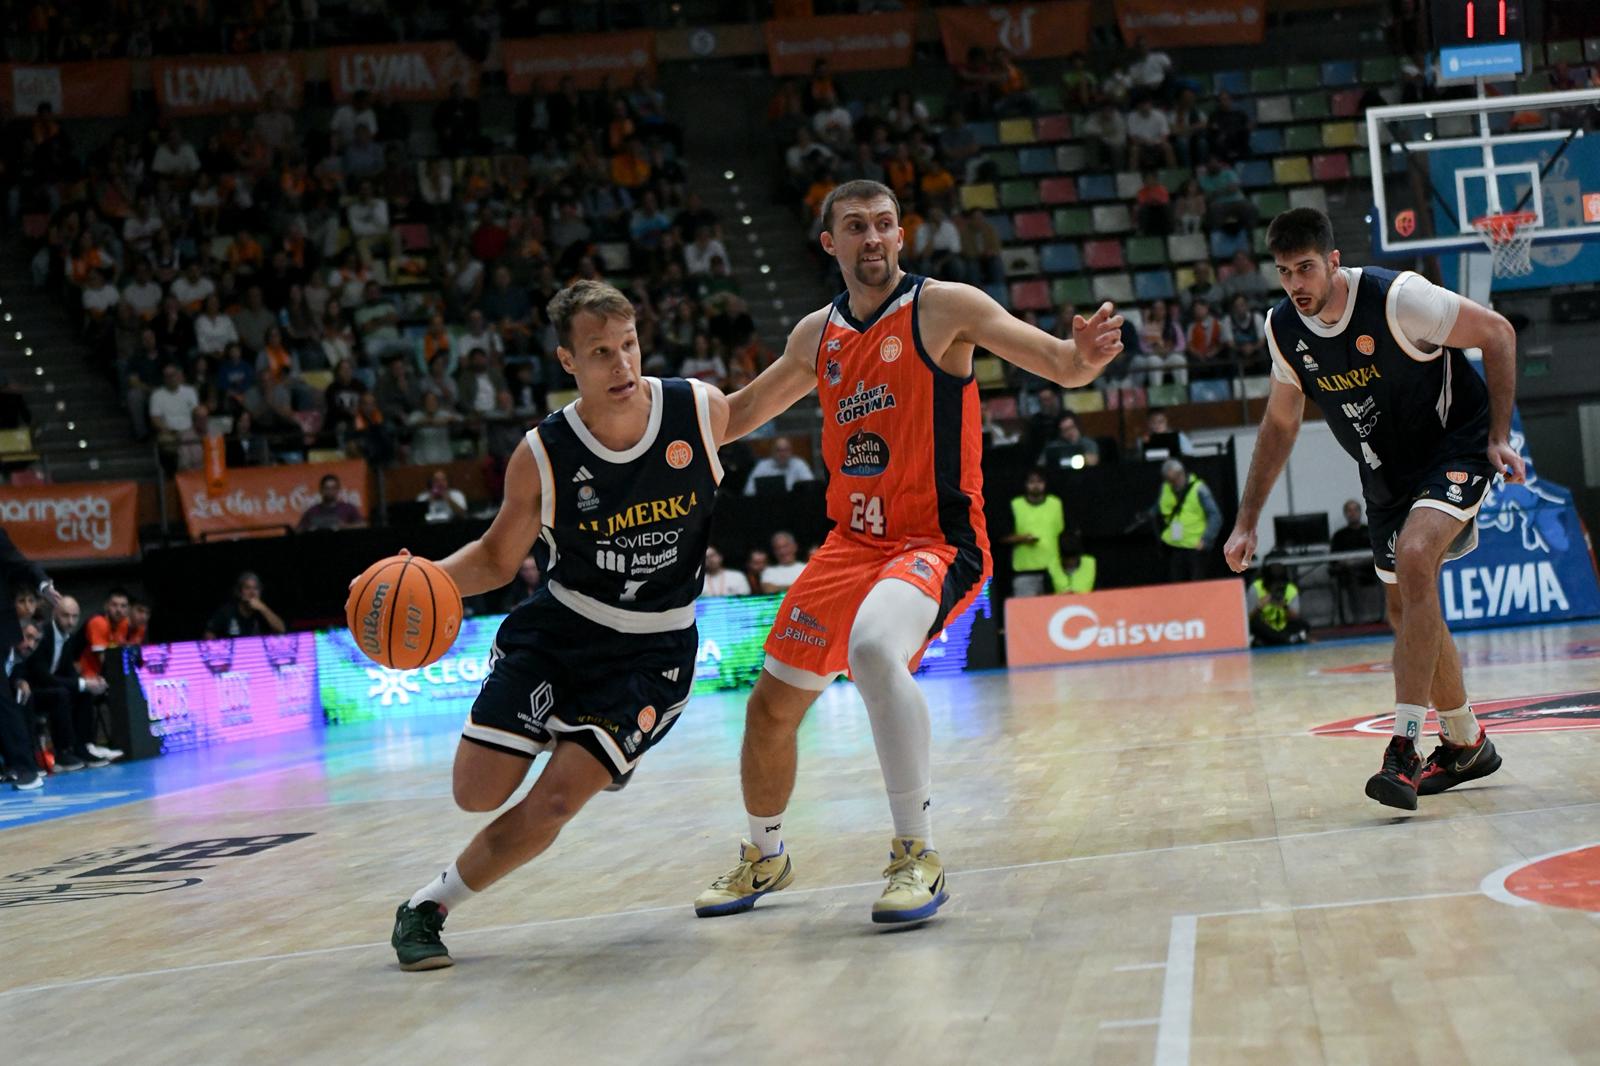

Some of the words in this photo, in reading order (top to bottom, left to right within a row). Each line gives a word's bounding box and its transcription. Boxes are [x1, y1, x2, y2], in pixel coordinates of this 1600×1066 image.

[163, 65, 257, 106] LEYMA
[340, 53, 436, 94] LEYMA
[1316, 363, 1383, 392] ALIMRKA
[839, 384, 887, 409] BASQUET
[844, 452, 880, 467] Galicia
[850, 492, 885, 535] 24
[56, 516, 112, 550] city
[615, 531, 679, 549] OVIEDO
[631, 546, 678, 567] Asturias
[1442, 561, 1570, 621] LEYMA
[363, 583, 390, 656] Wilson
[778, 626, 828, 648] galicia
